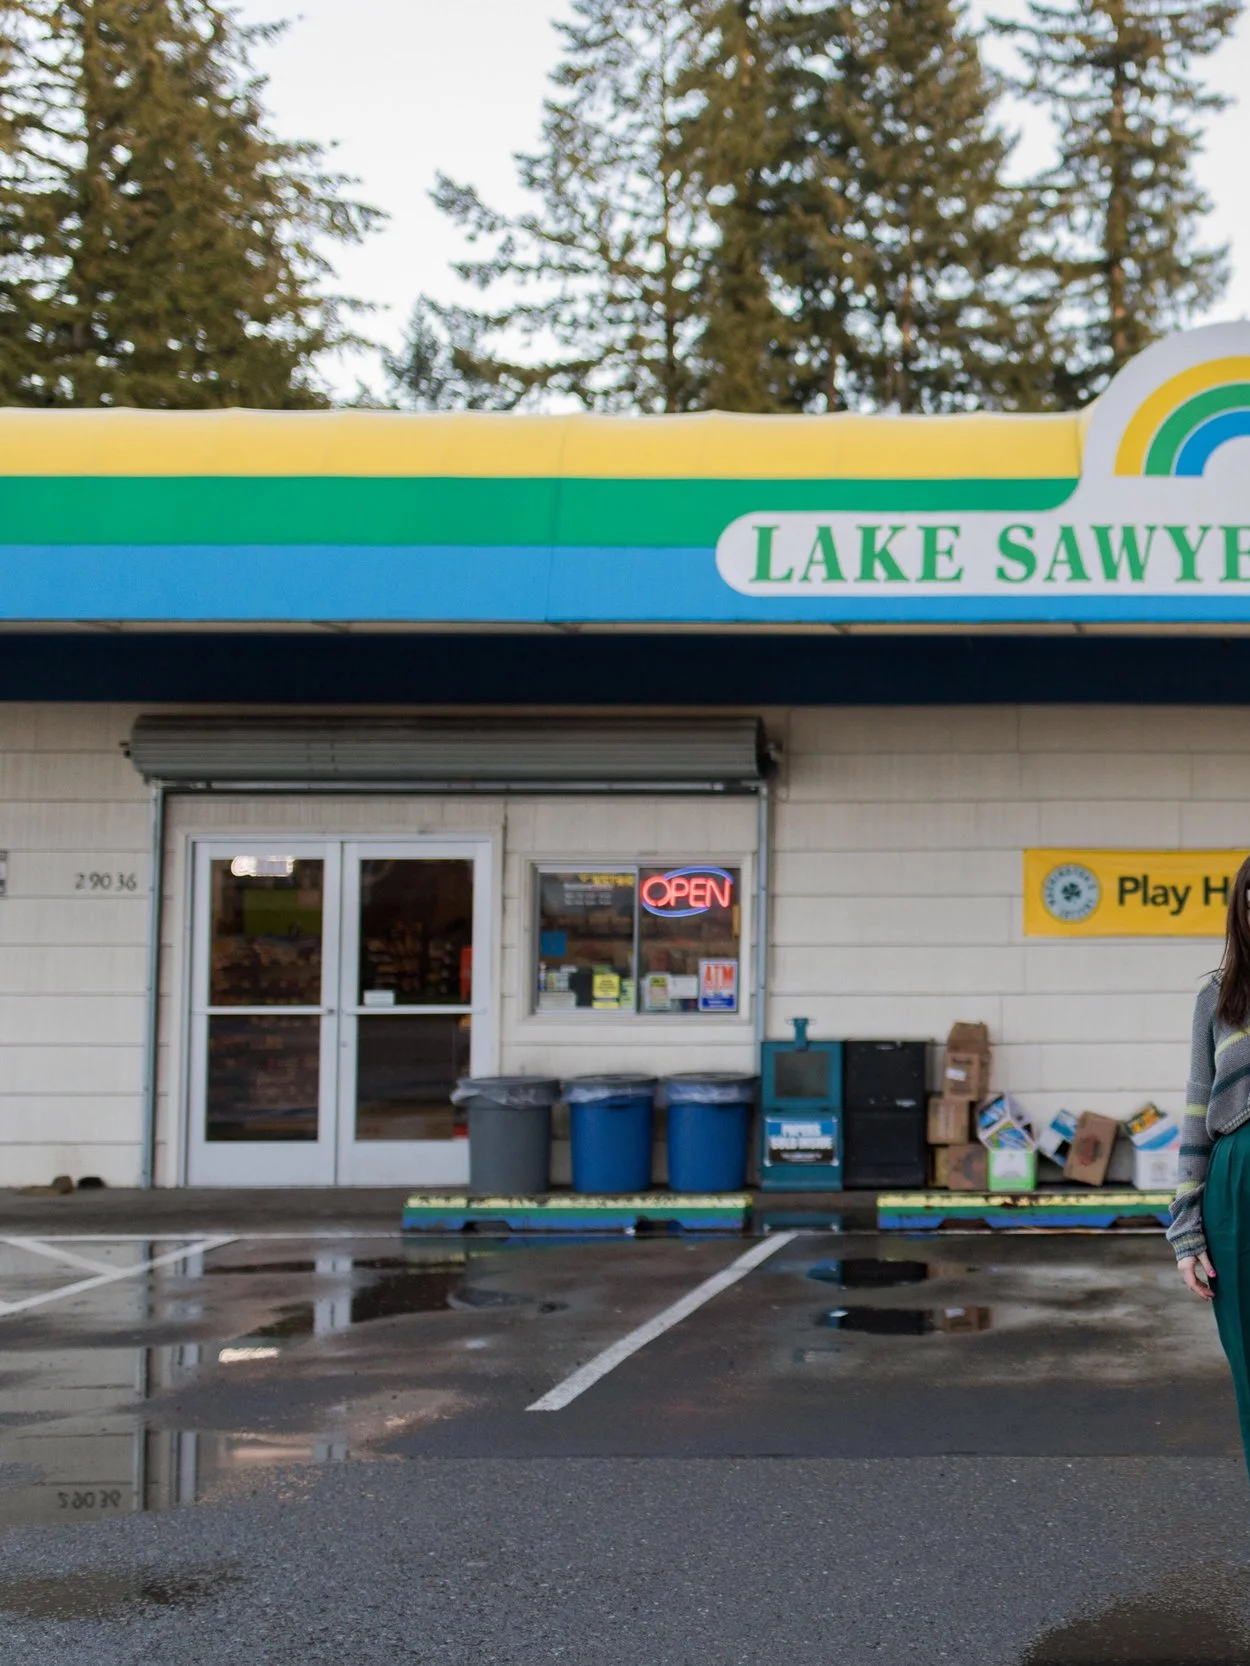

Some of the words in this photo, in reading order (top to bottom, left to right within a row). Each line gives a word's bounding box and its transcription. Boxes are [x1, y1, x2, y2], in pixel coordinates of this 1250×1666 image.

[748, 525, 965, 584] LAKE
[74, 871, 138, 892] 29036
[642, 876, 731, 908] OPEN
[1118, 875, 1192, 917] Play
